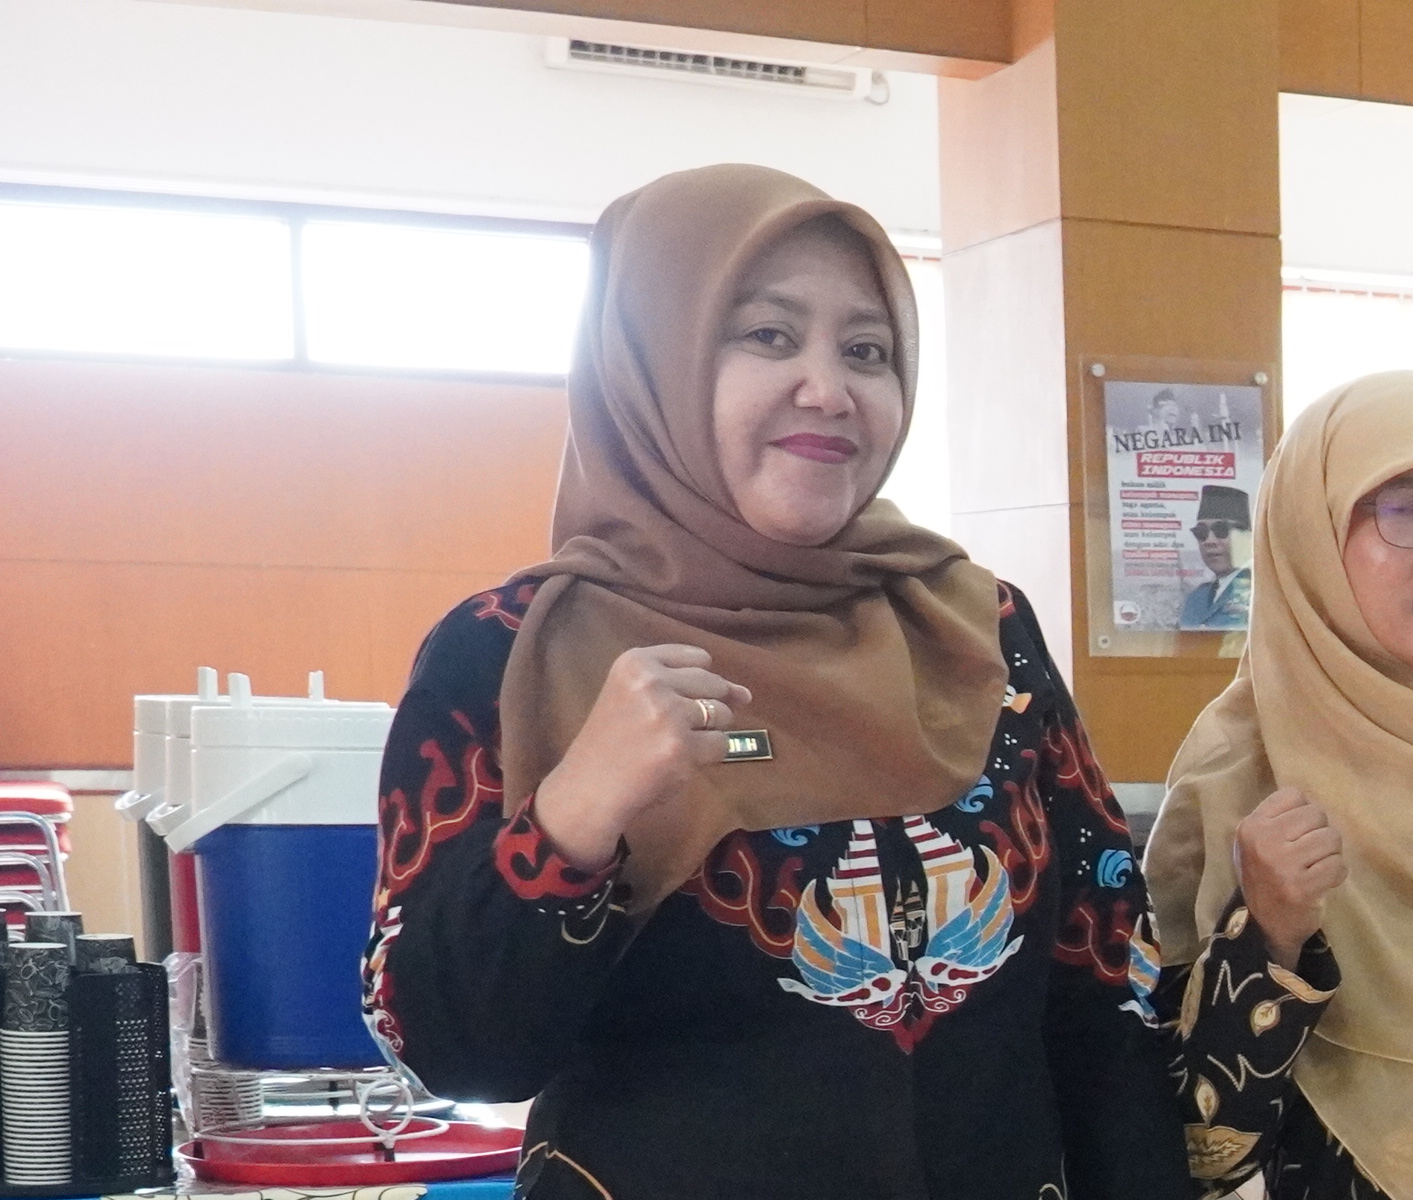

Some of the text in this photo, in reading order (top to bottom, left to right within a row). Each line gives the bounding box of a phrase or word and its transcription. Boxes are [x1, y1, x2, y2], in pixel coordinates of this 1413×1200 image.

[1113, 422, 1242, 453] NEGARA INI
[1141, 453, 1225, 465] REPUBLIK
[1142, 465, 1235, 477] INDONESIA
